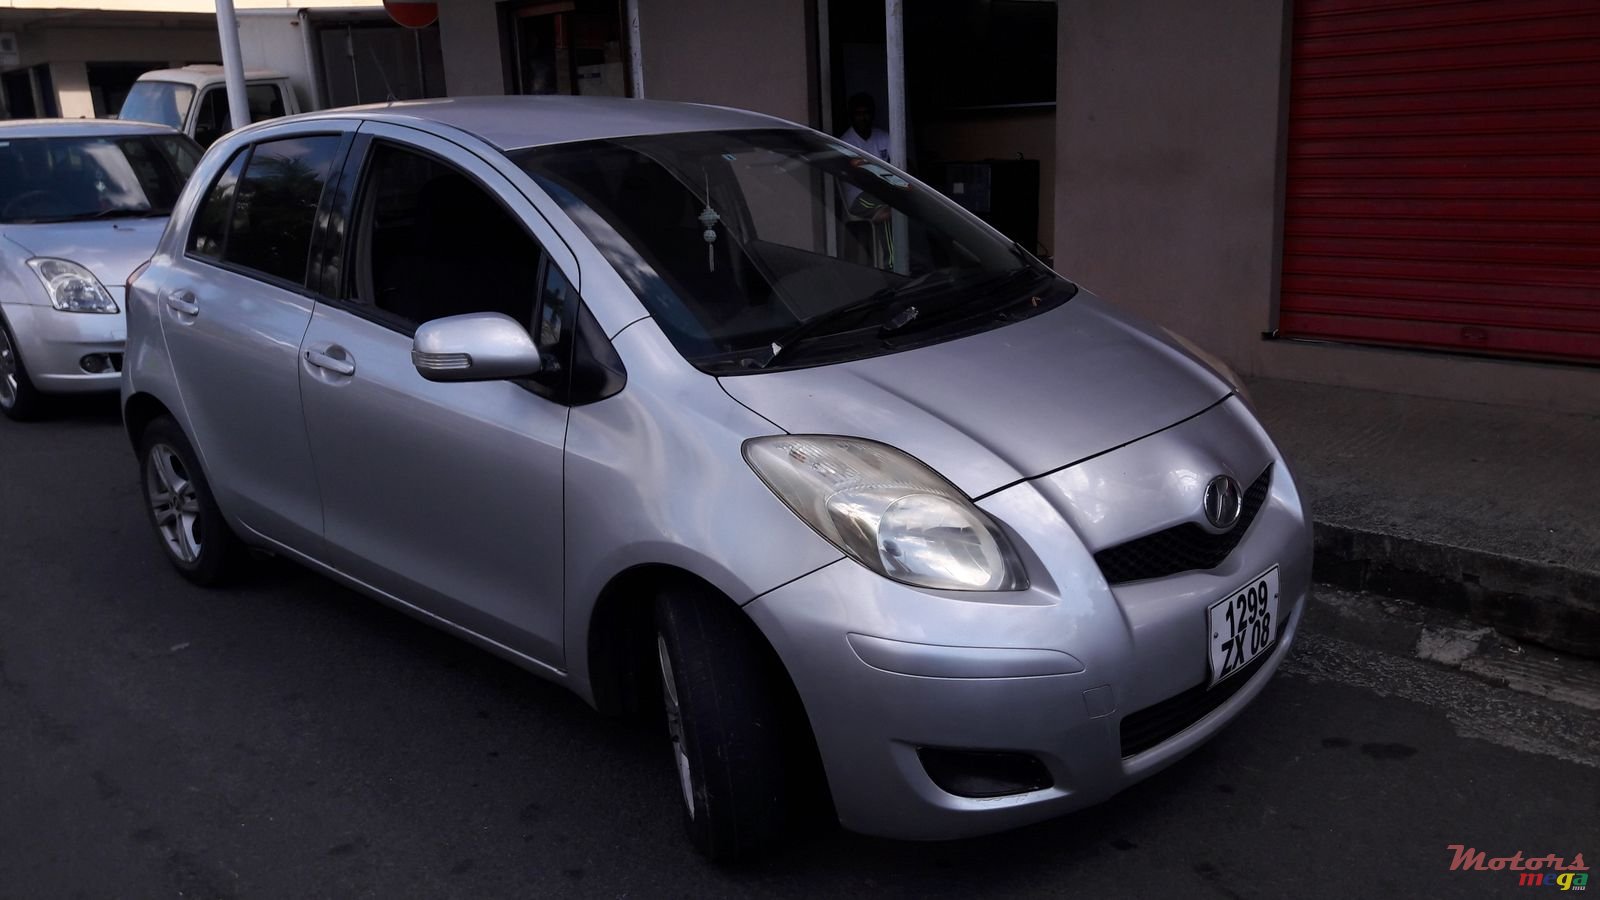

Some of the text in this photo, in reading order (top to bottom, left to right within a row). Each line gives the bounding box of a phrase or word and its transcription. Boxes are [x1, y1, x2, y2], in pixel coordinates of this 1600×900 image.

[1225, 580, 1268, 639] 1299
[1220, 612, 1271, 676] ZX 08
